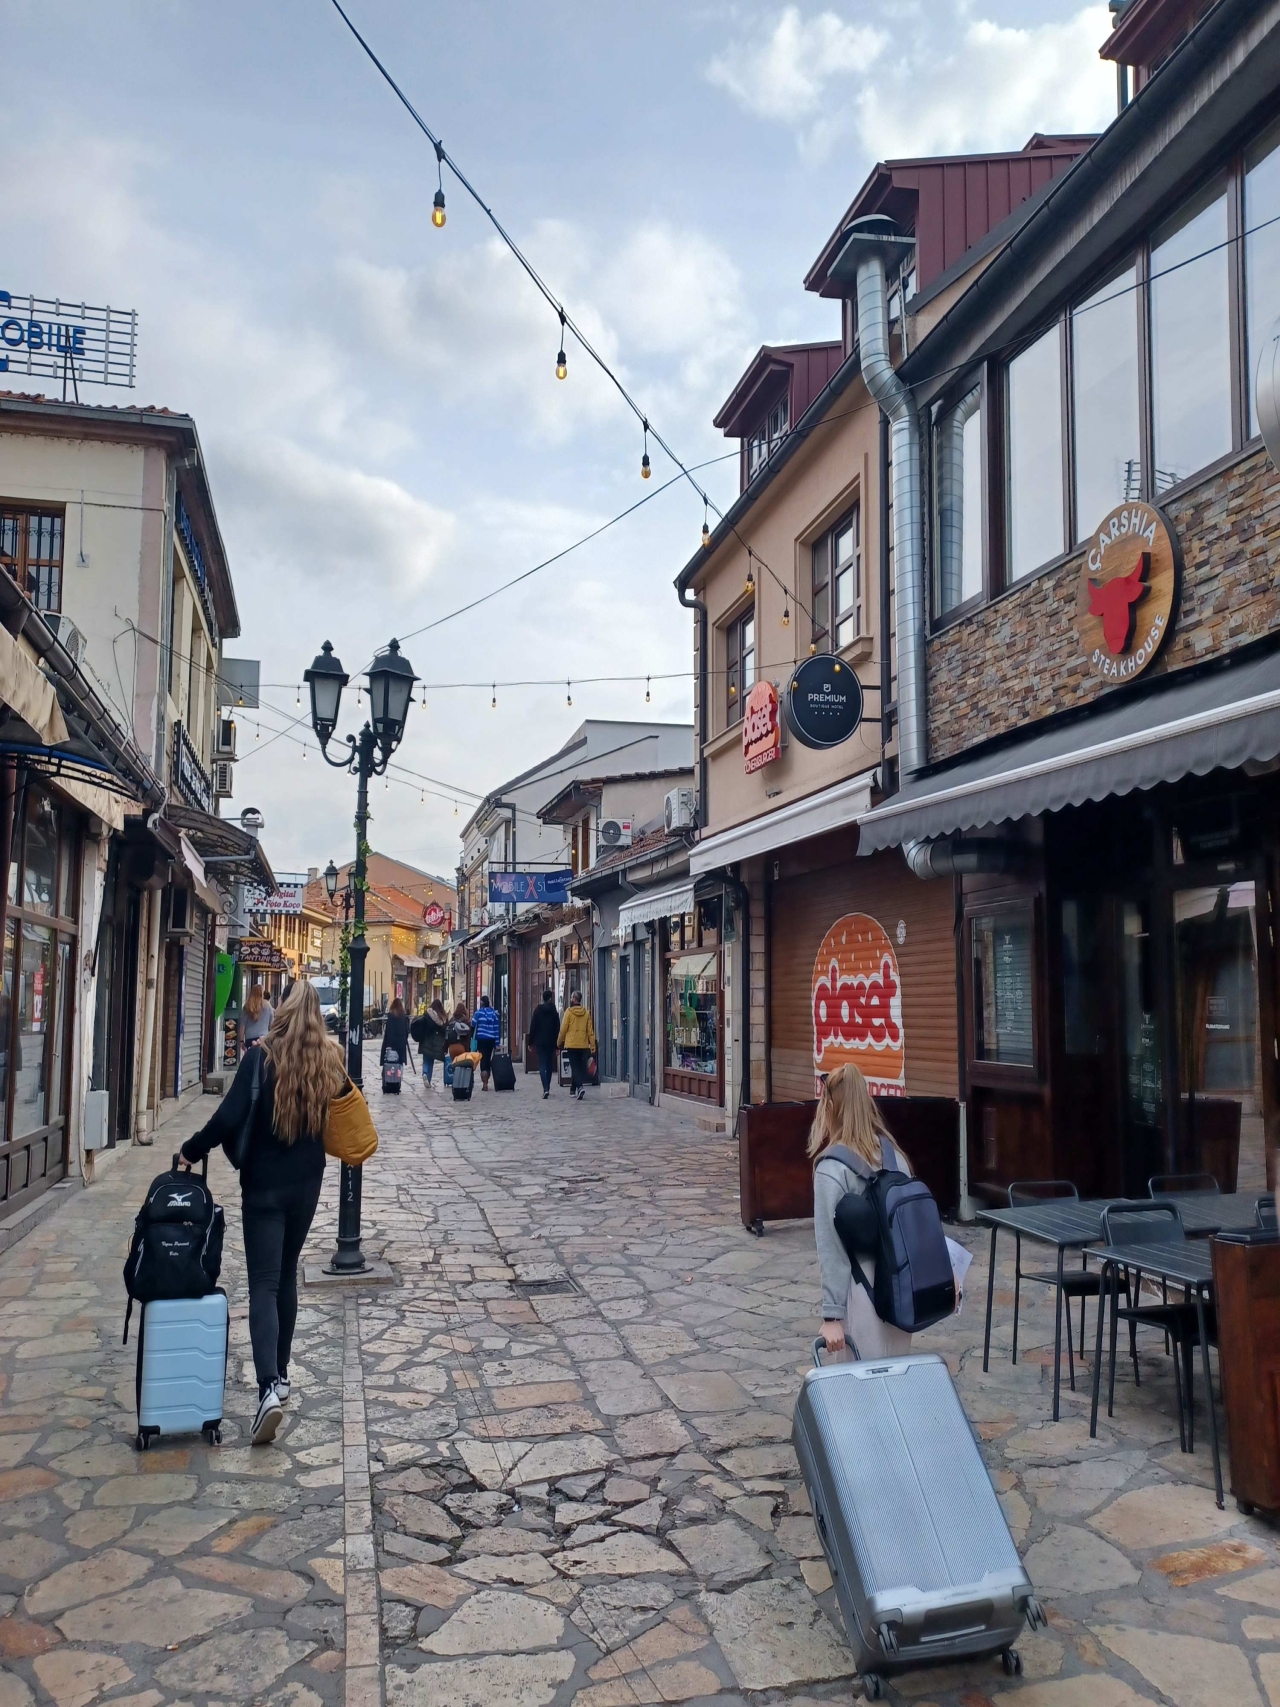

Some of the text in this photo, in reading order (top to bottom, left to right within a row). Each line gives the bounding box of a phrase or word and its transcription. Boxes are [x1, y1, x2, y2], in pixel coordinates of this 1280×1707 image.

[1092, 614, 1165, 677] STEAKHOUSE
[808, 693, 847, 703] PREMIUM
[492, 880, 525, 893] MOBILE
[524, 875, 538, 899] X
[265, 900, 282, 908] Foto
